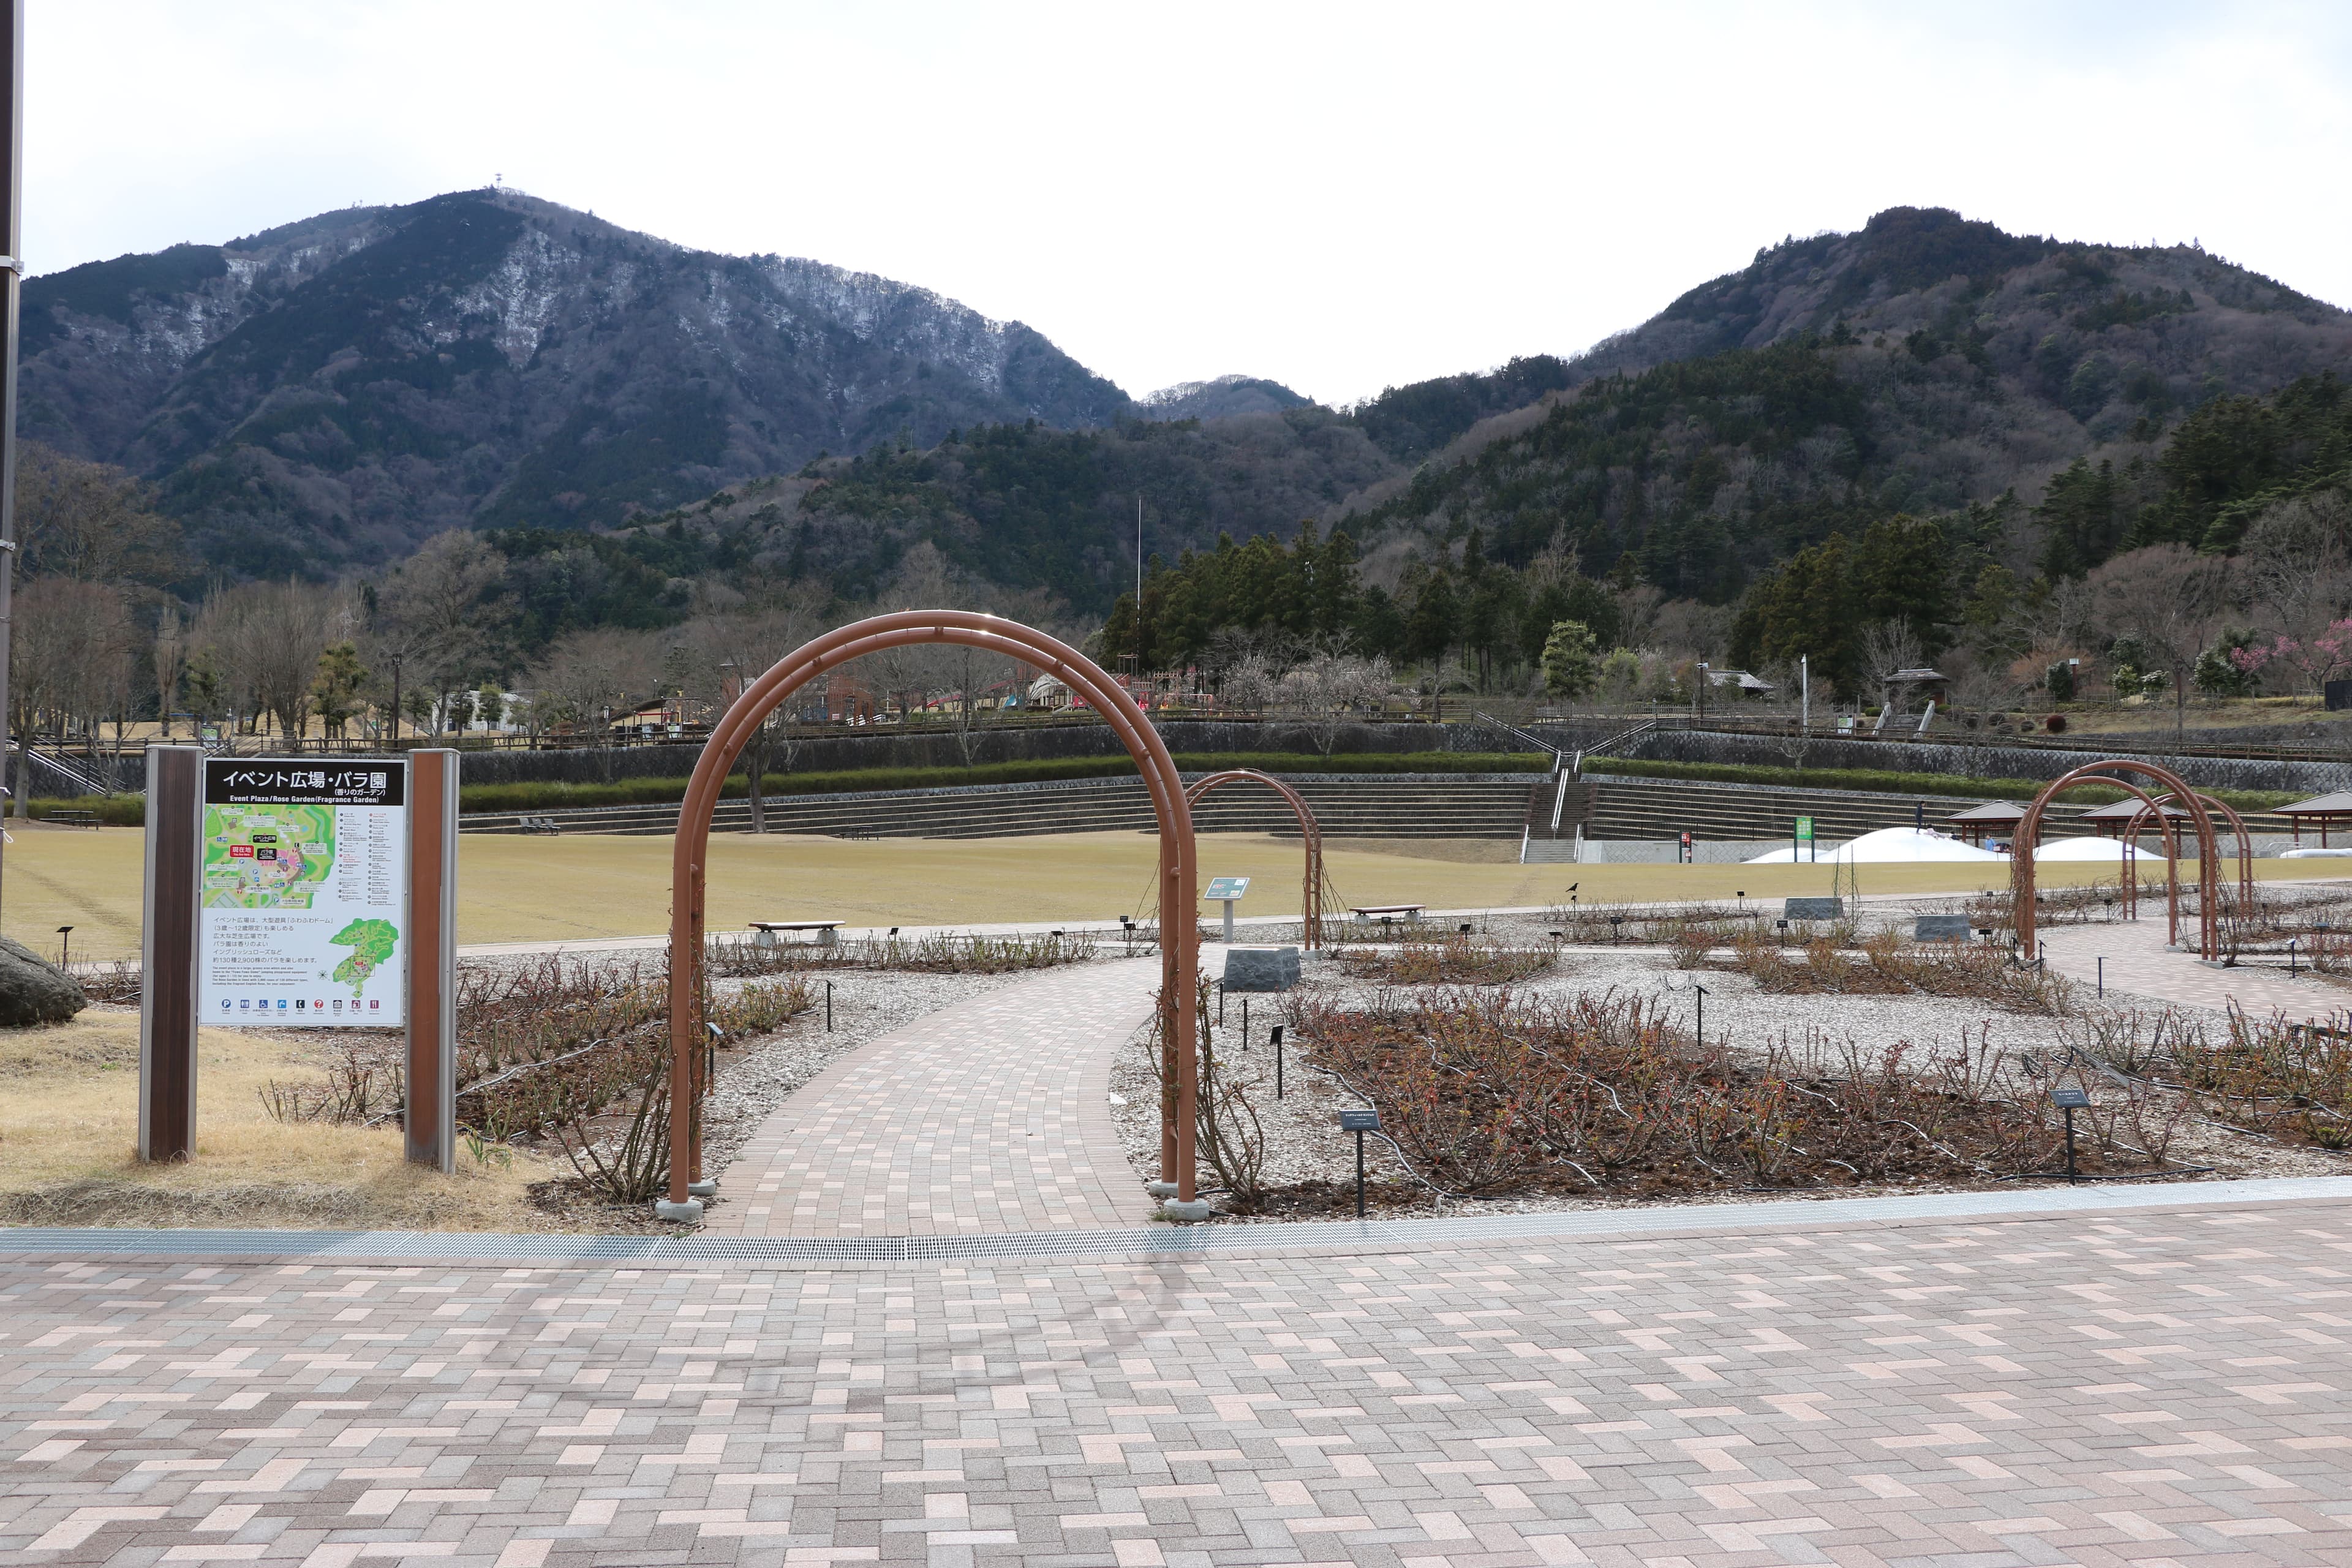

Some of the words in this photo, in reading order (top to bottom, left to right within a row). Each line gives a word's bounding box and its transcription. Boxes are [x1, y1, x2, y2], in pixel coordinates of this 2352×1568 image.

[223, 771, 387, 789] イベント広場・バラ園
